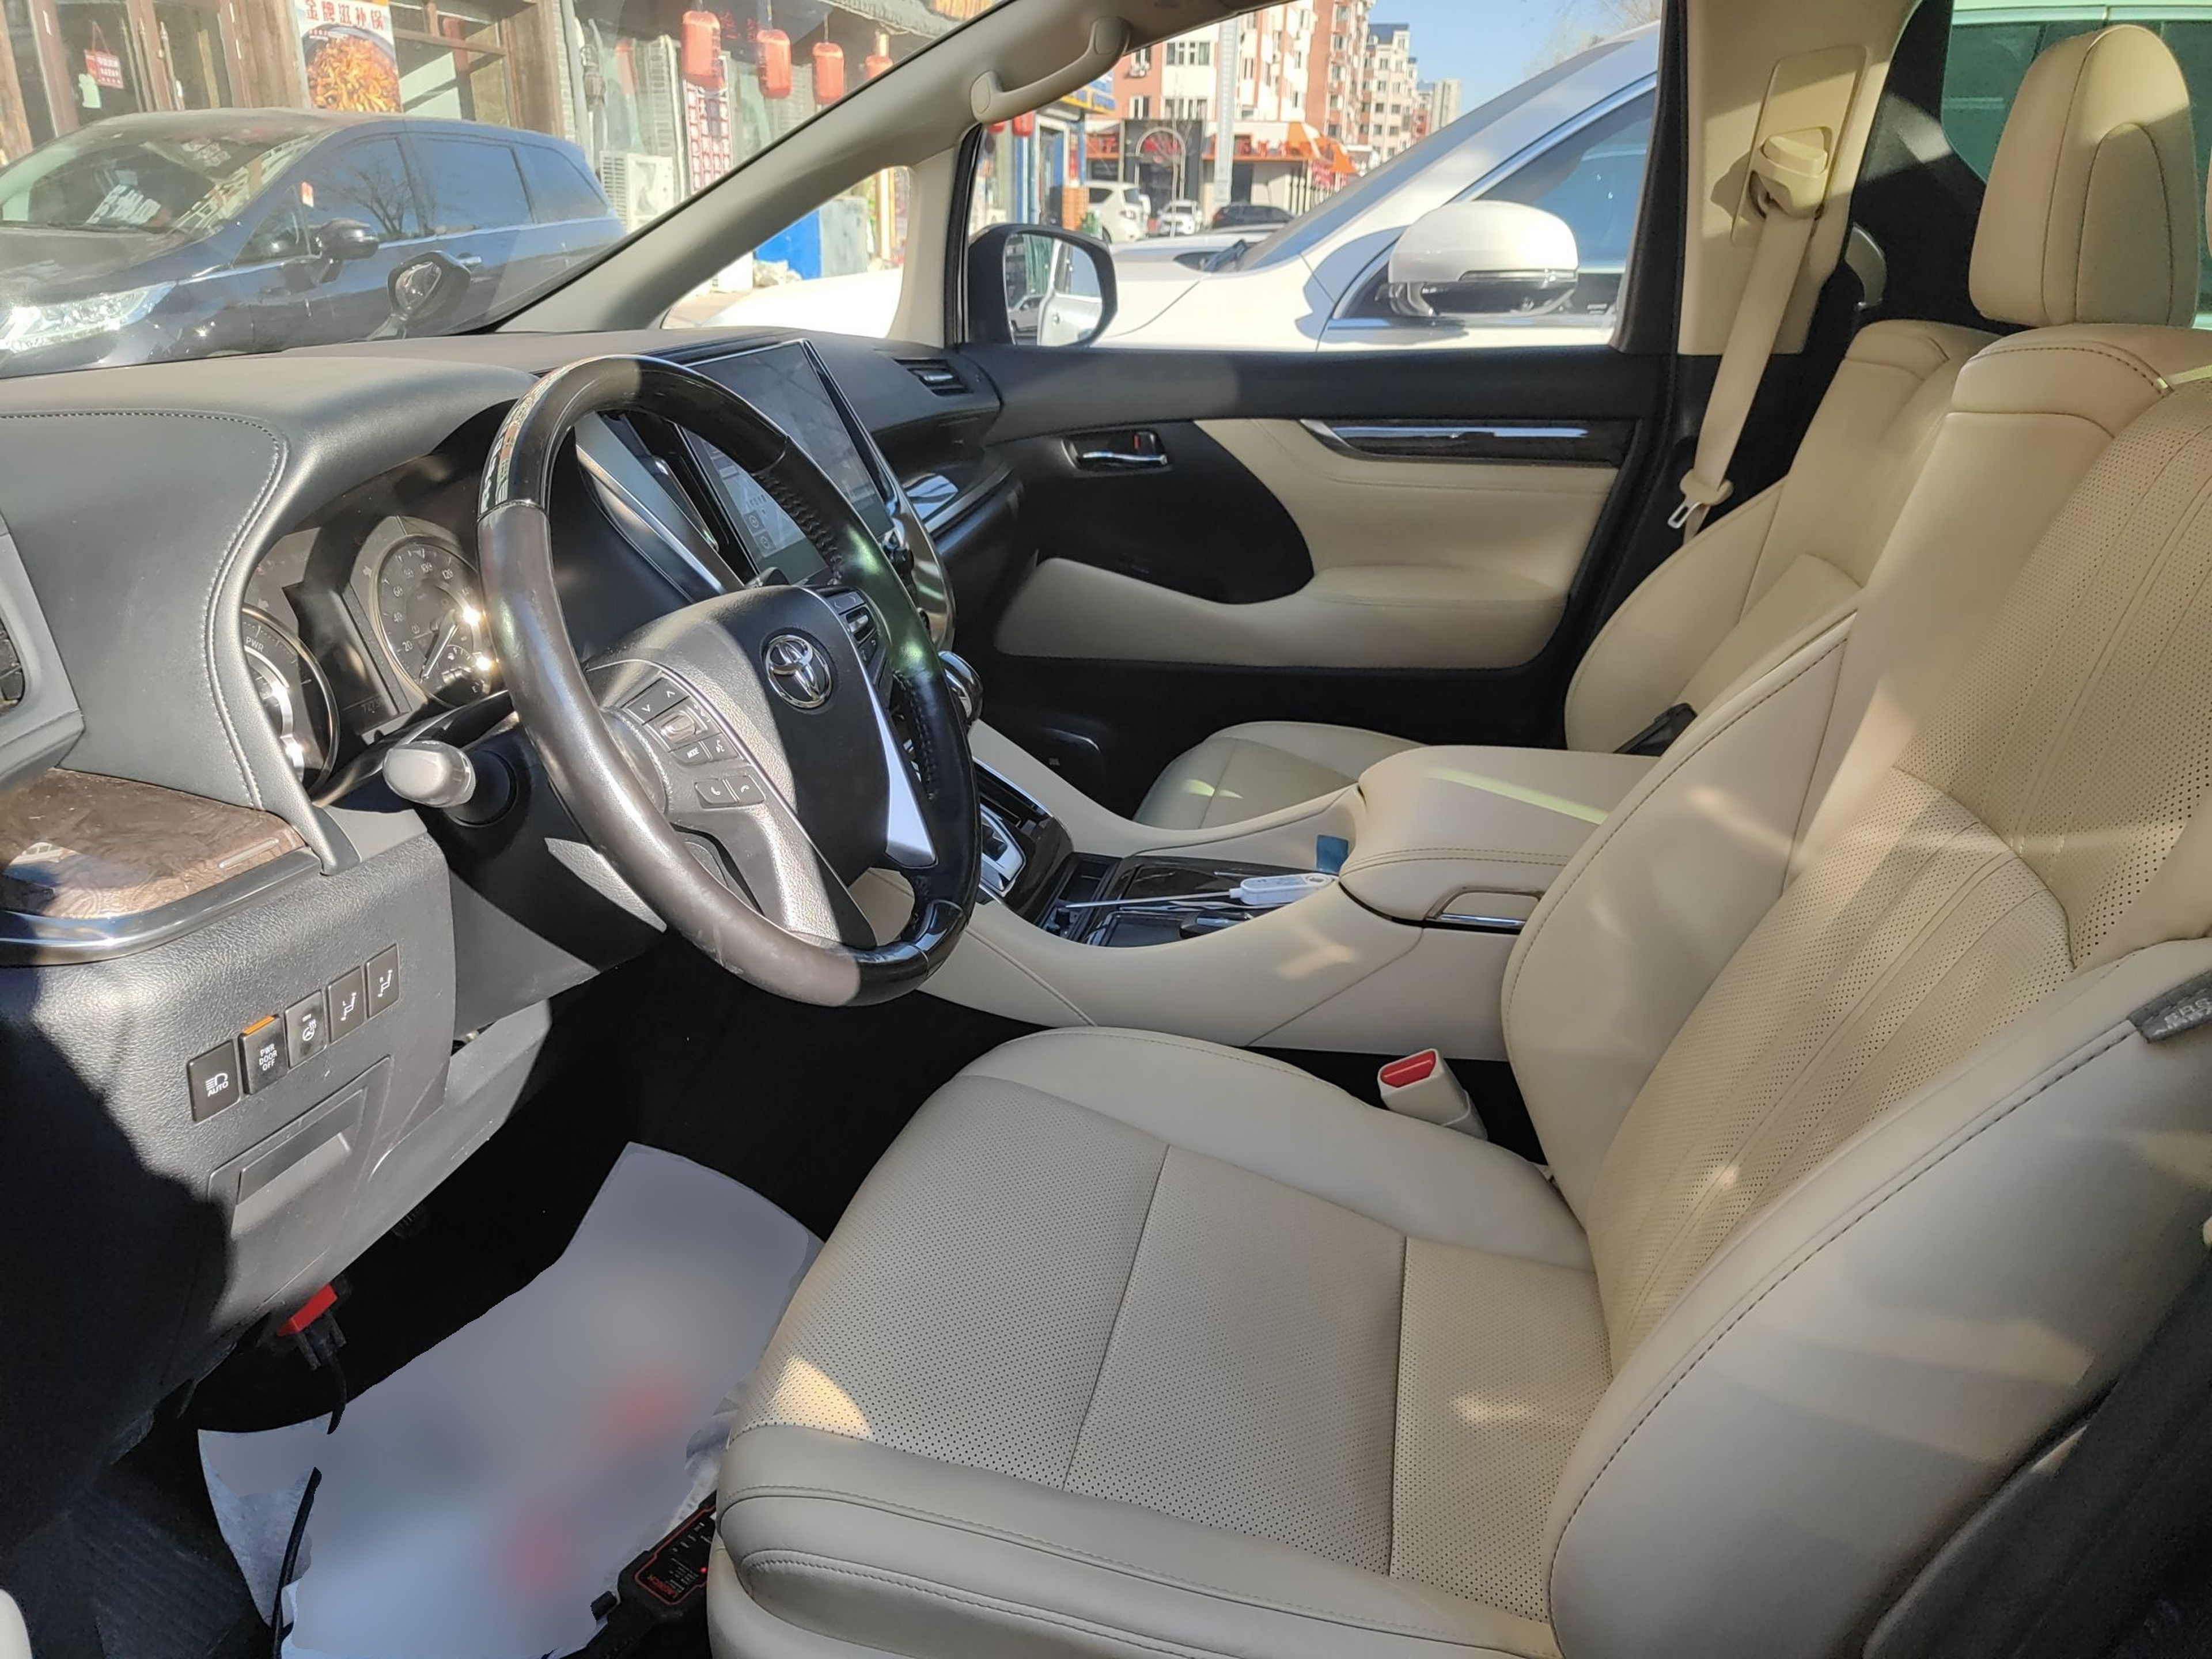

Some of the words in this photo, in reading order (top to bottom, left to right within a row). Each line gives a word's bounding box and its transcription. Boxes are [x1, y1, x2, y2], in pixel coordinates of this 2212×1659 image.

[393, 585, 403, 597] 60
[393, 611, 404, 623] 40
[245, 635, 265, 653] PWR
[402, 640, 414, 652] 20
[686, 747, 700, 759] MODE
[259, 1043, 275, 1057] PWR
[258, 1049, 278, 1066] DOOR
[262, 1058, 276, 1071] OFF
[207, 1080, 229, 1097] AUTO
